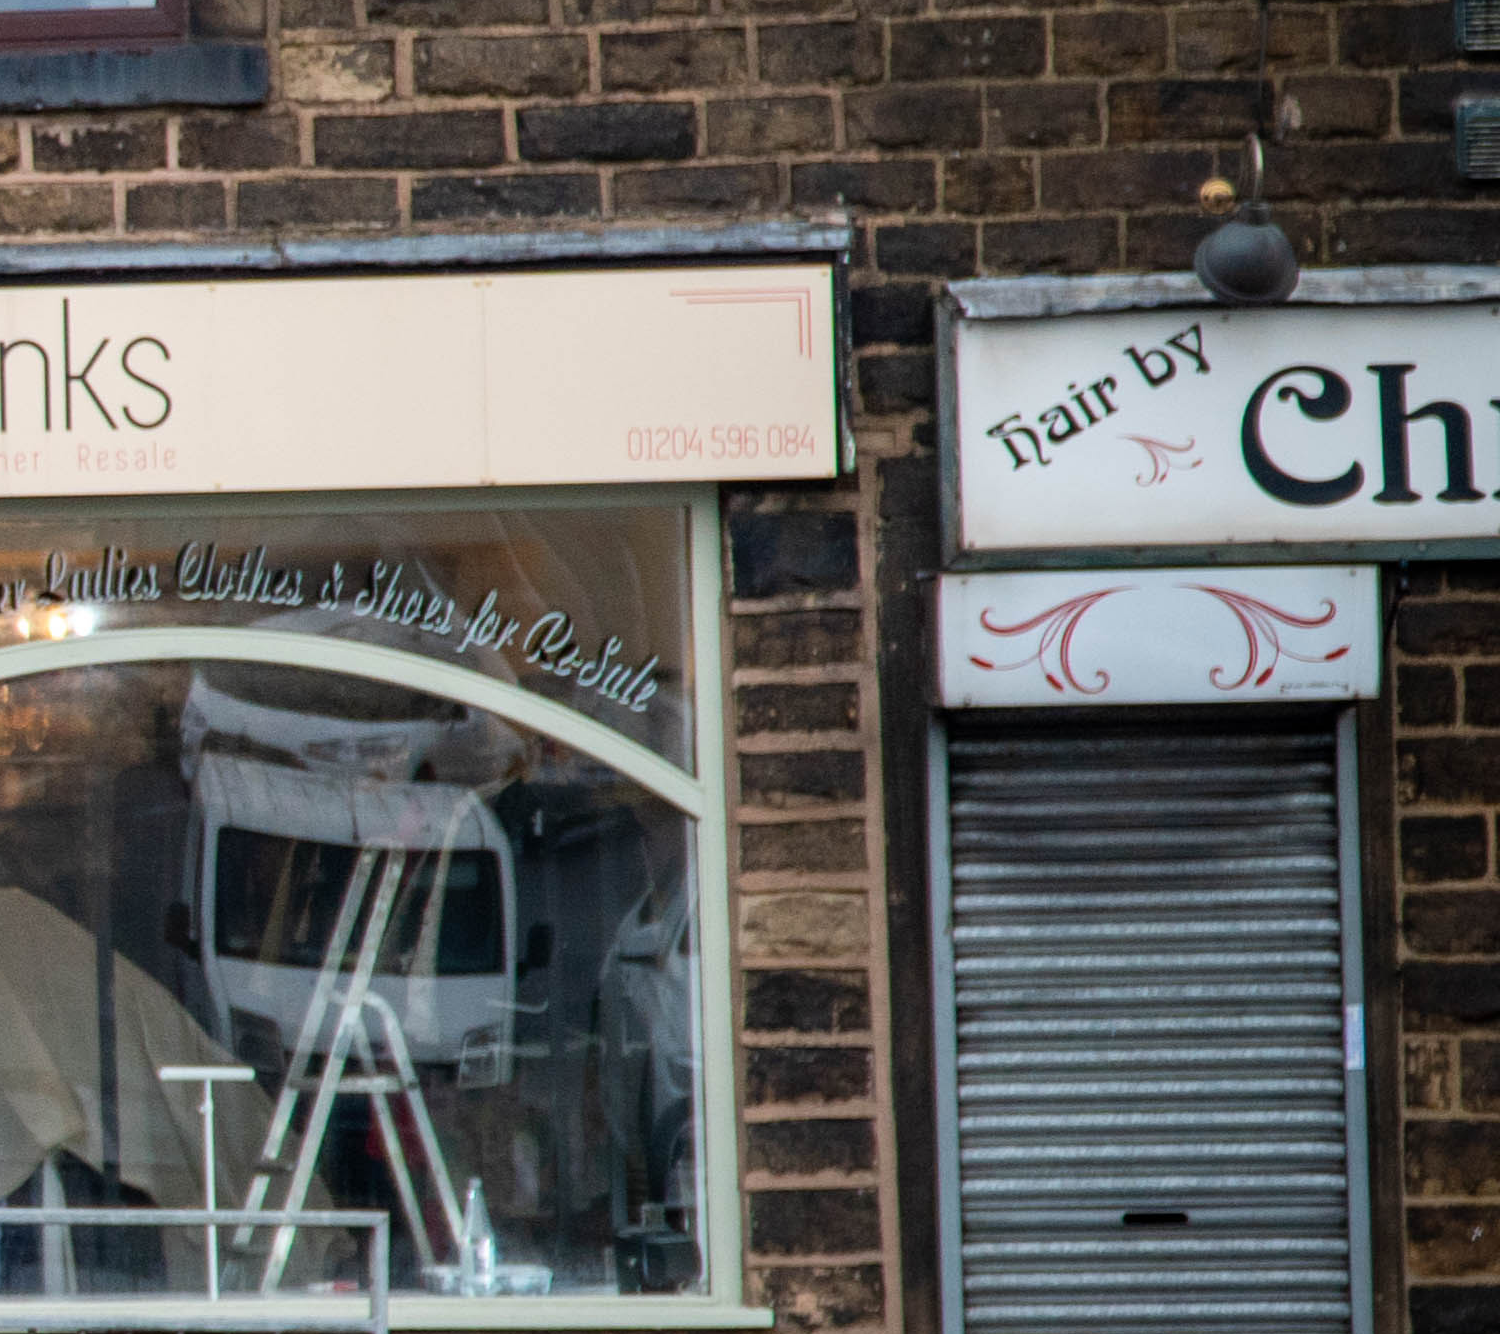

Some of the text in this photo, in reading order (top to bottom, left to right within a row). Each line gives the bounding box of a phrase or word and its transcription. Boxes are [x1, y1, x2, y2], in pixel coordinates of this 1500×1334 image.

[627, 423, 815, 462] 01204 596 084
[985, 322, 1211, 471] hair by
[1240, 363, 1500, 507] Ch
[77, 441, 178, 472] Resale
[37, 544, 162, 606] Ladies
[176, 540, 305, 607] Clothes
[354, 558, 456, 636] Shoes
[456, 587, 519, 655] for
